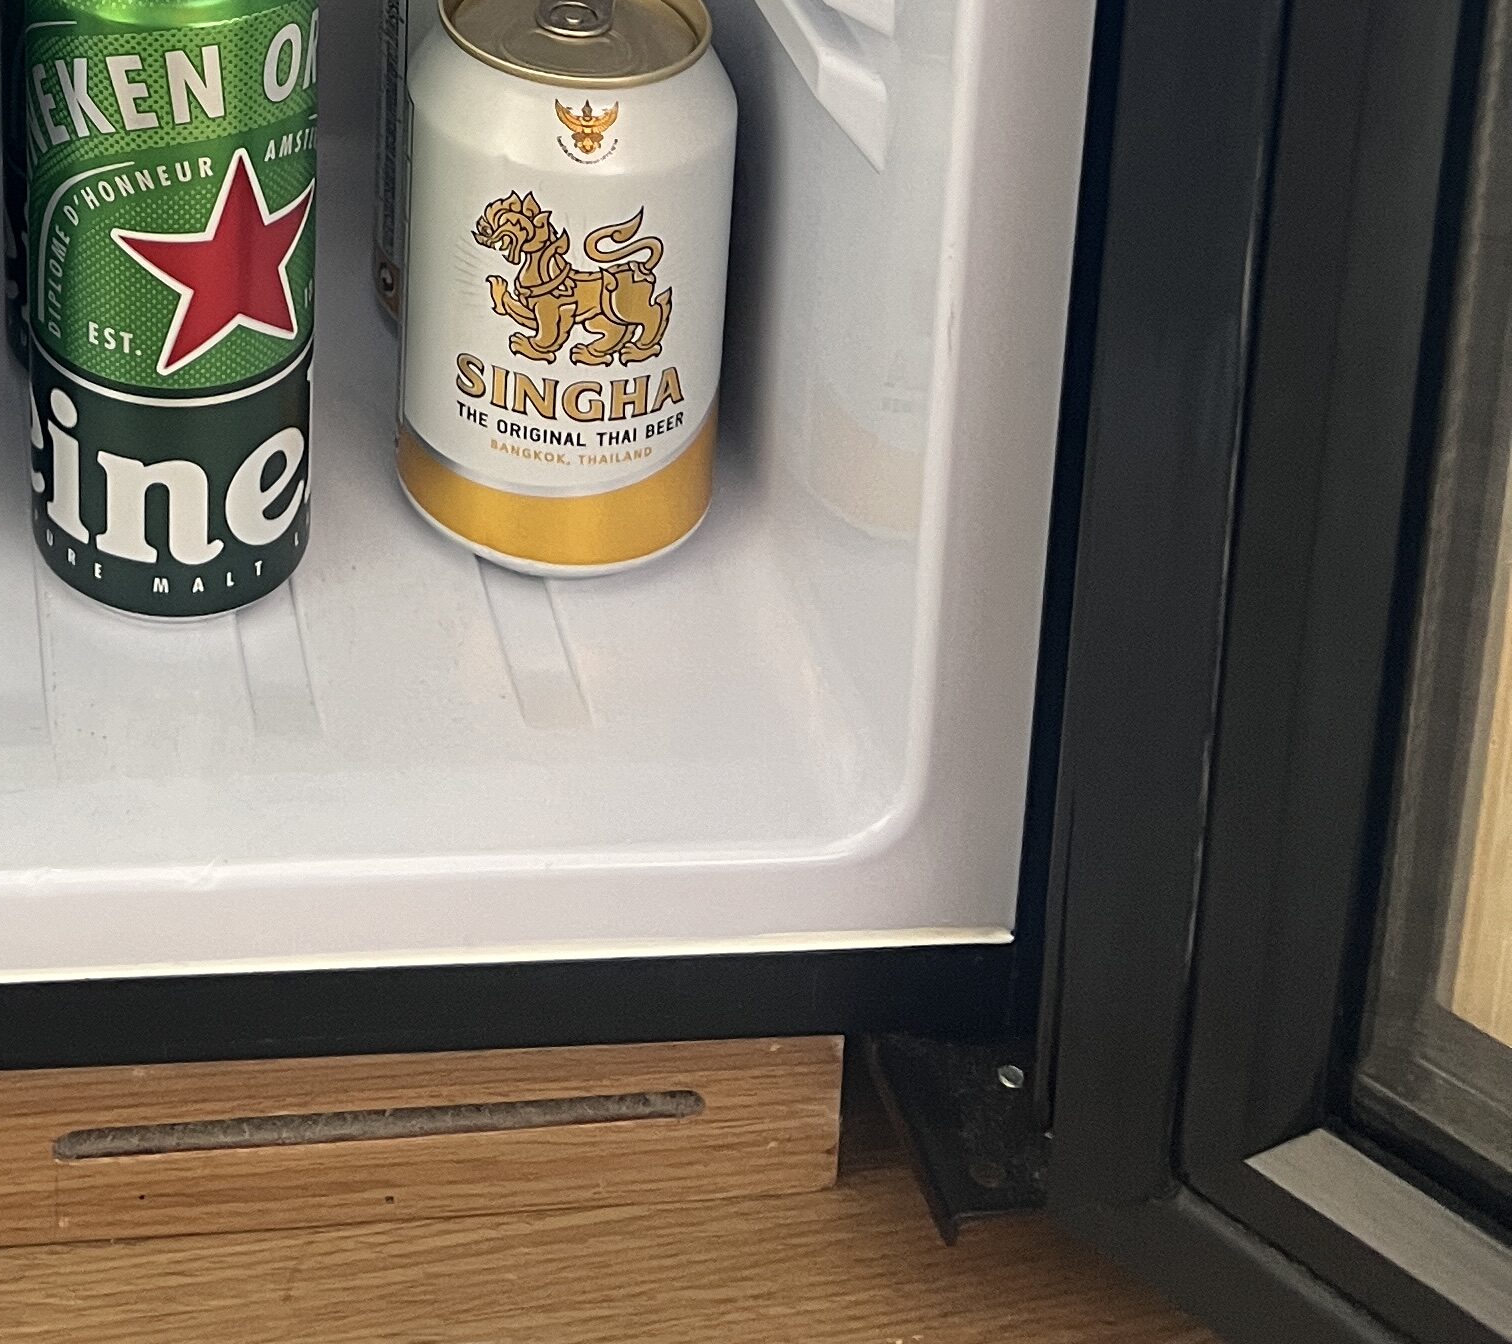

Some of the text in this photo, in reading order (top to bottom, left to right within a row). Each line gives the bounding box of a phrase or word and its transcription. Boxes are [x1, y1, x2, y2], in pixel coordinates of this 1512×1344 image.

[263, 7, 319, 103] OR
[62, 156, 215, 227] D'HONNEUR
[87, 321, 143, 357] EST.
[455, 352, 685, 423] SINGHA
[457, 400, 684, 448] THE ORIGINAL THAI BEER
[578, 446, 653, 466] THAILAND
[45, 527, 102, 579] URE
[152, 560, 263, 594] MALT
